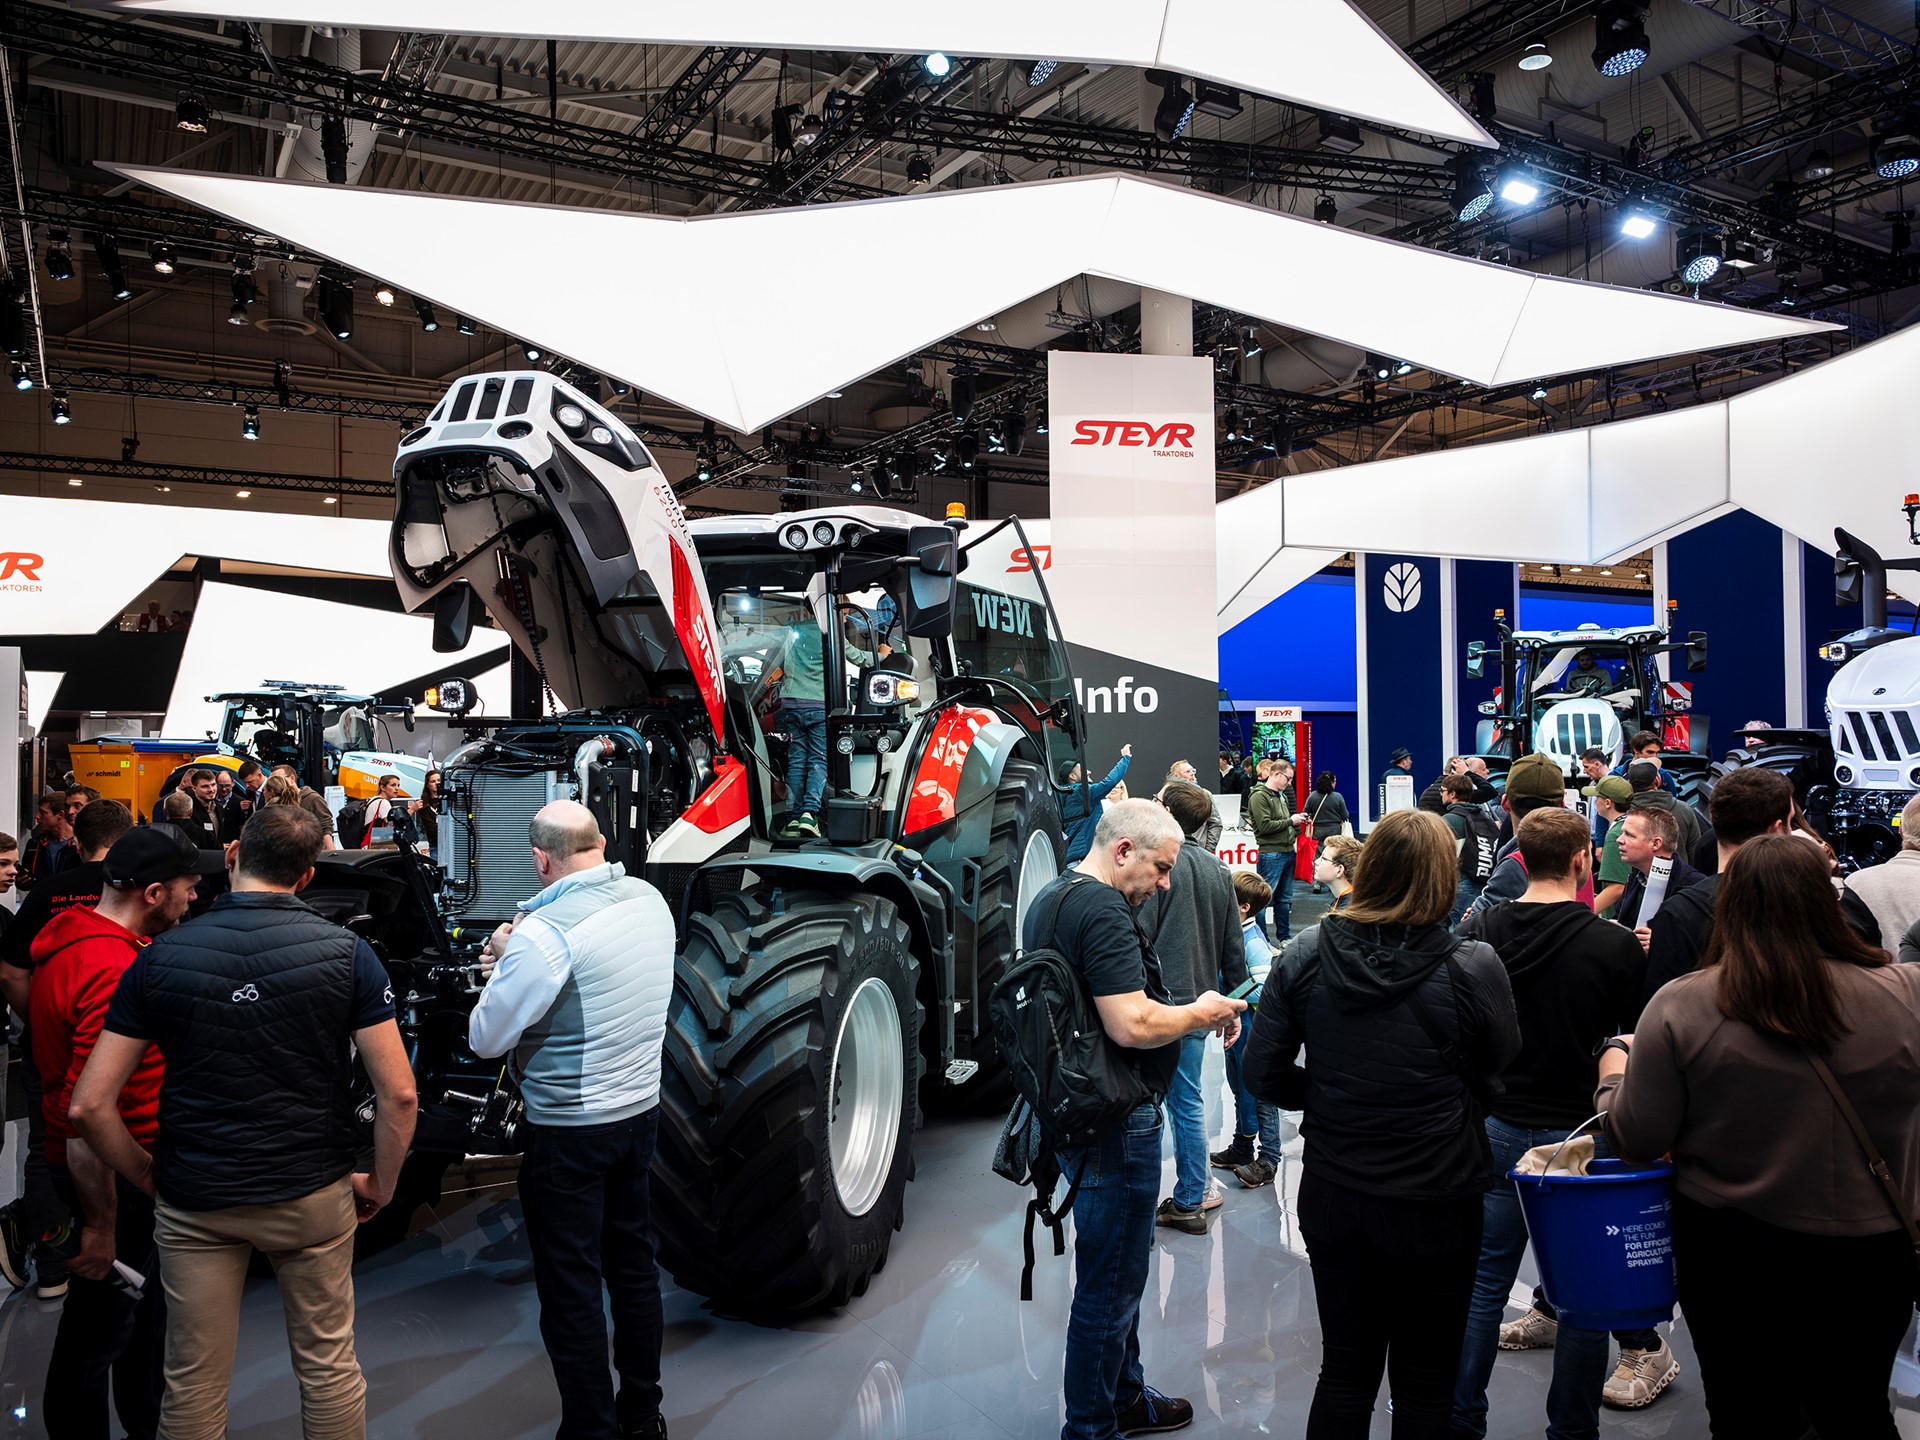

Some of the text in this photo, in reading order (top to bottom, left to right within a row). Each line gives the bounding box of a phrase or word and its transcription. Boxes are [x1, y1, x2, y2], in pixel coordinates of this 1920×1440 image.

[1070, 420, 1195, 448] STEYR
[1153, 450, 1194, 458] TRAKTOREN
[653, 486, 678, 529] 6200
[661, 484, 692, 549] IMPULS
[692, 614, 721, 703] STEYR
[1074, 676, 1159, 714] Info
[370, 758, 393, 768] STEYR
[1213, 843, 1259, 865] nfo
[1476, 835, 1494, 877] PUMA
[1622, 1220, 1666, 1233] HERE COMES
[1623, 1233, 1640, 1242] THE
[1624, 1242, 1642, 1251] FOR
